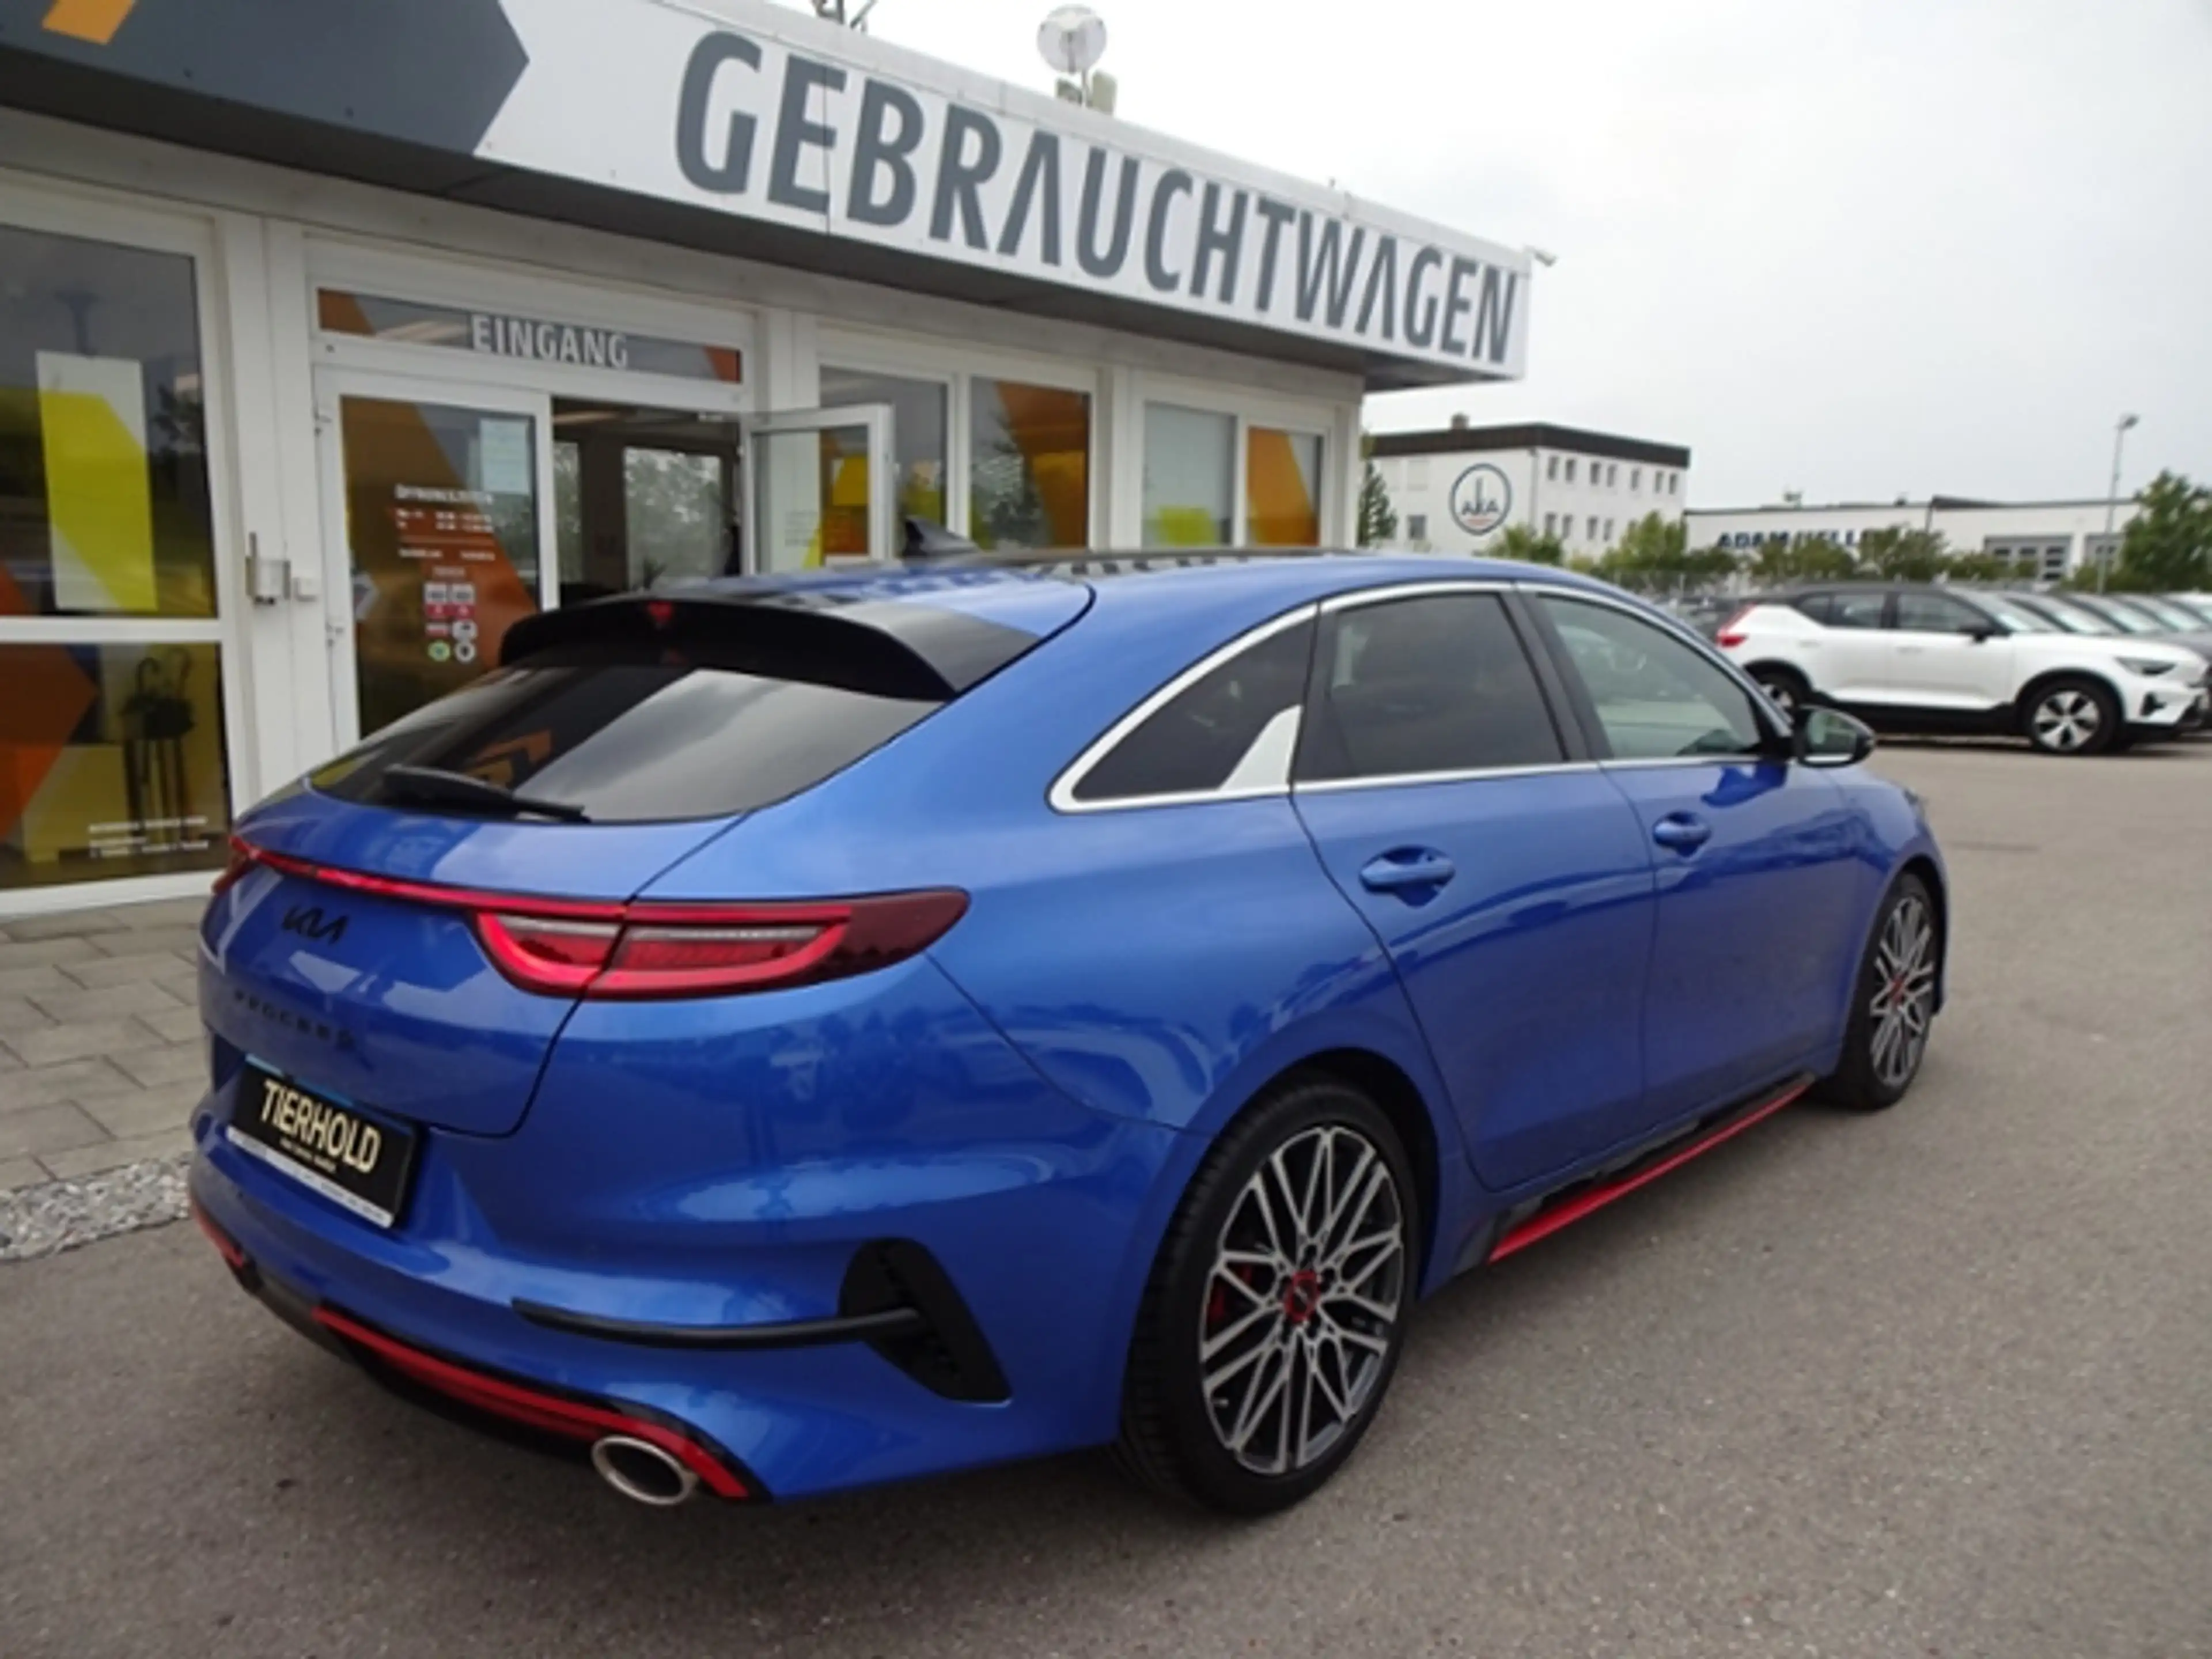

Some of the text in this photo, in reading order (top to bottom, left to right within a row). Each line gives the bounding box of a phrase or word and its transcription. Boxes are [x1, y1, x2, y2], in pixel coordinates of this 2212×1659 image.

[676, 30, 1518, 363] GEBRAUCHTWAGEN
[471, 315, 628, 368] EINGANG
[282, 905, 349, 945] KIA
[261, 1078, 381, 1173] TIERHOLD
